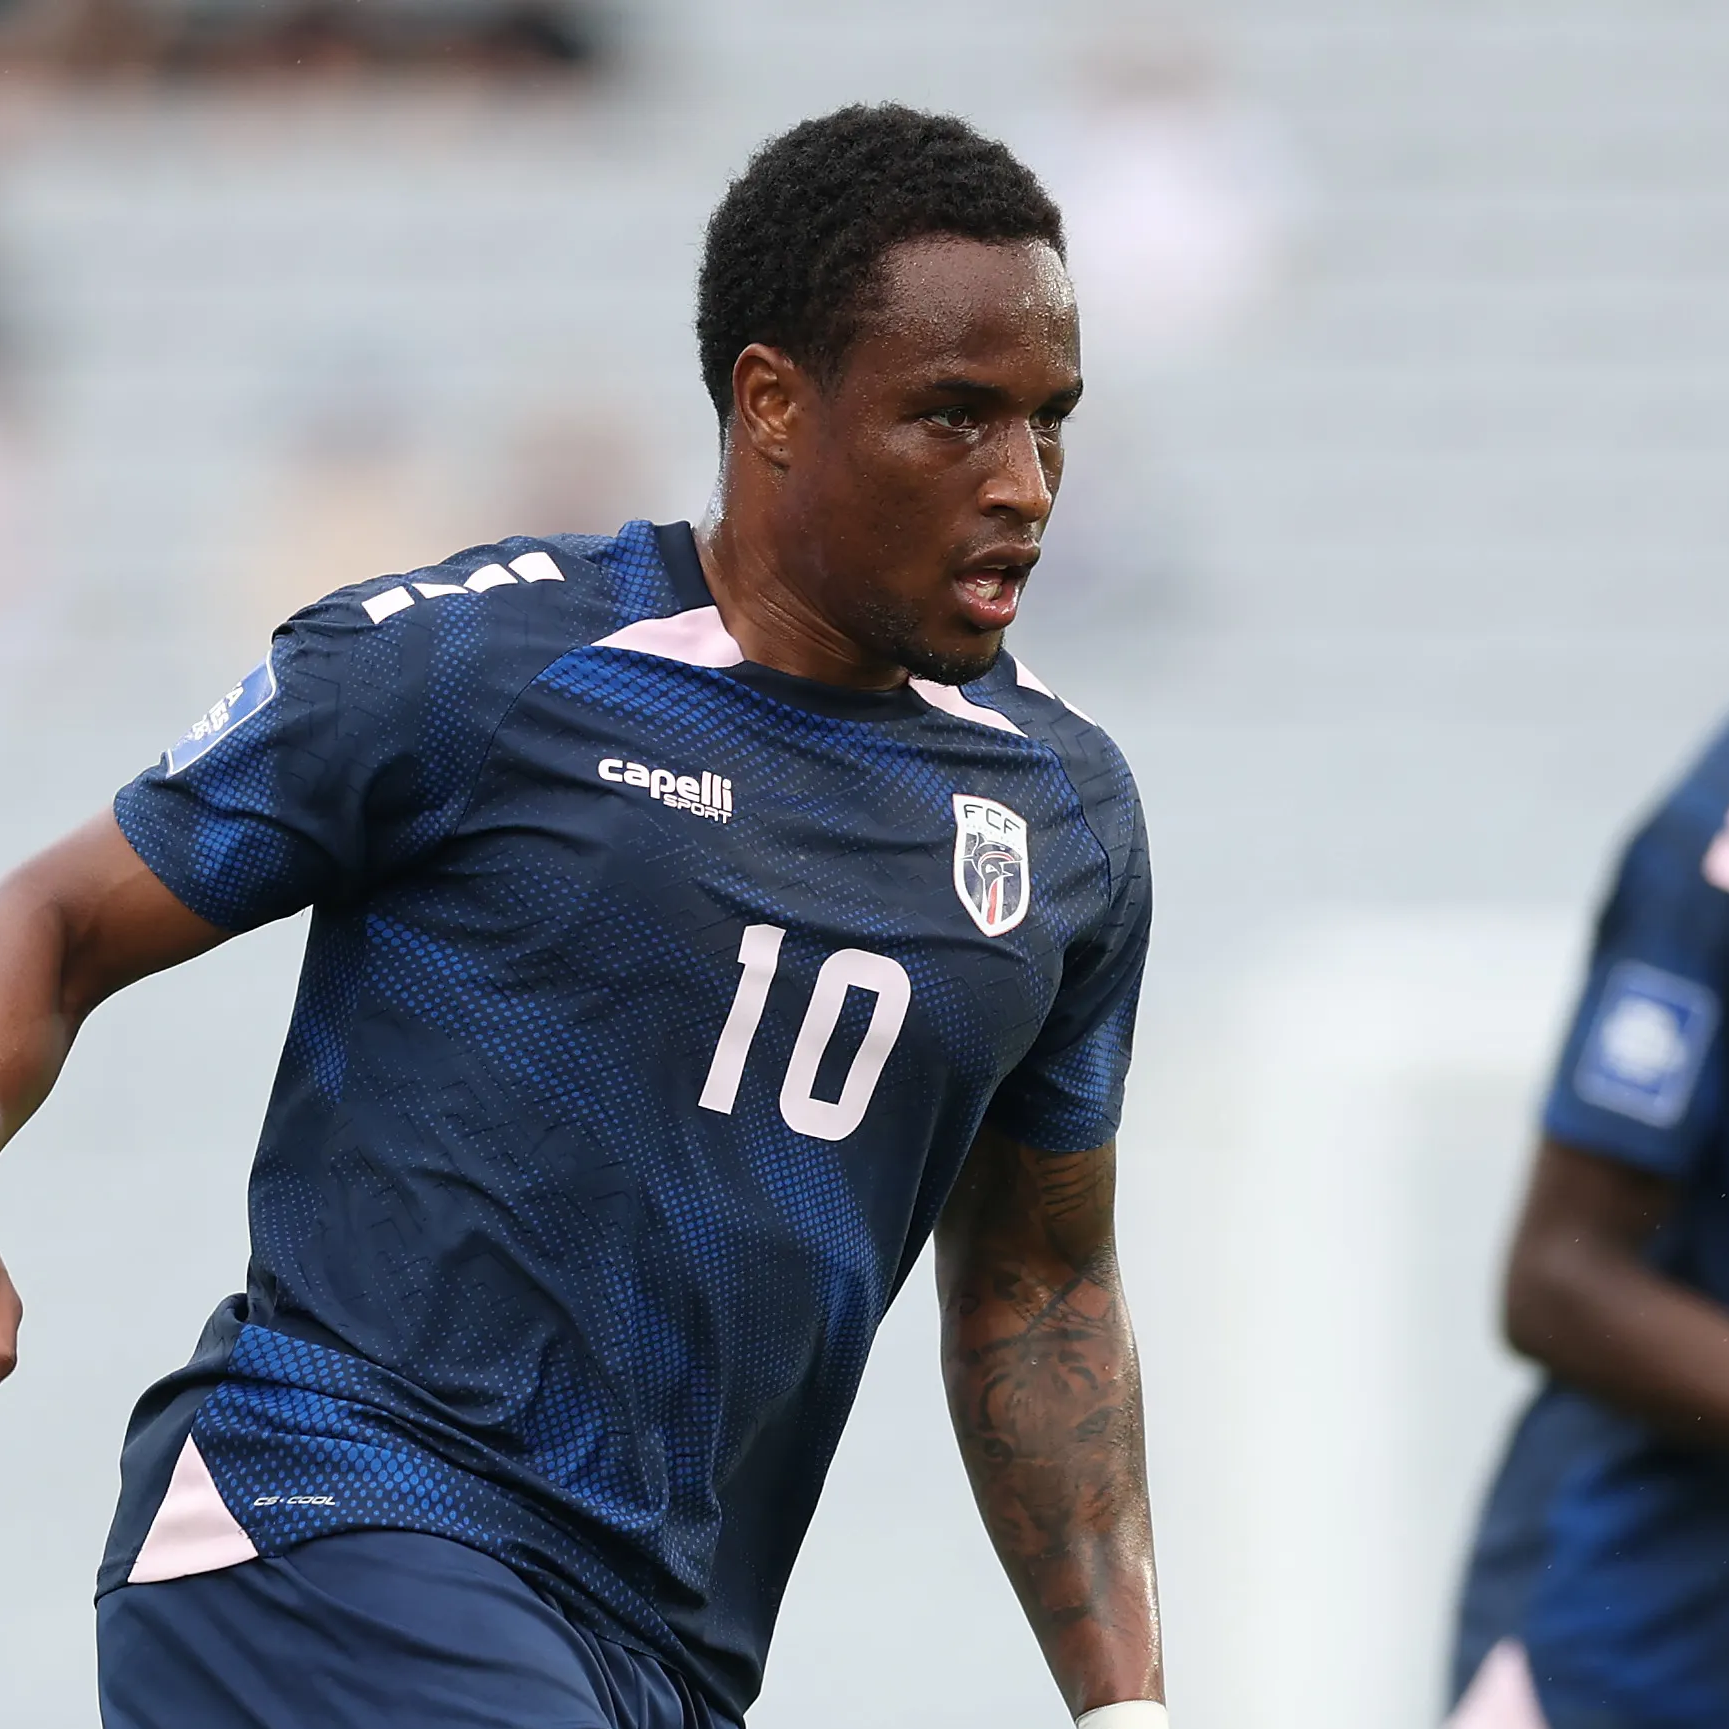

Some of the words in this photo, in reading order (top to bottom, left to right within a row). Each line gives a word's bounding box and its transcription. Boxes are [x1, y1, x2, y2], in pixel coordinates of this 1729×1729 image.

[598, 758, 733, 812] capelli
[663, 794, 733, 824] SPORT
[963, 804, 1021, 834] FCF
[698, 924, 912, 1142] 10
